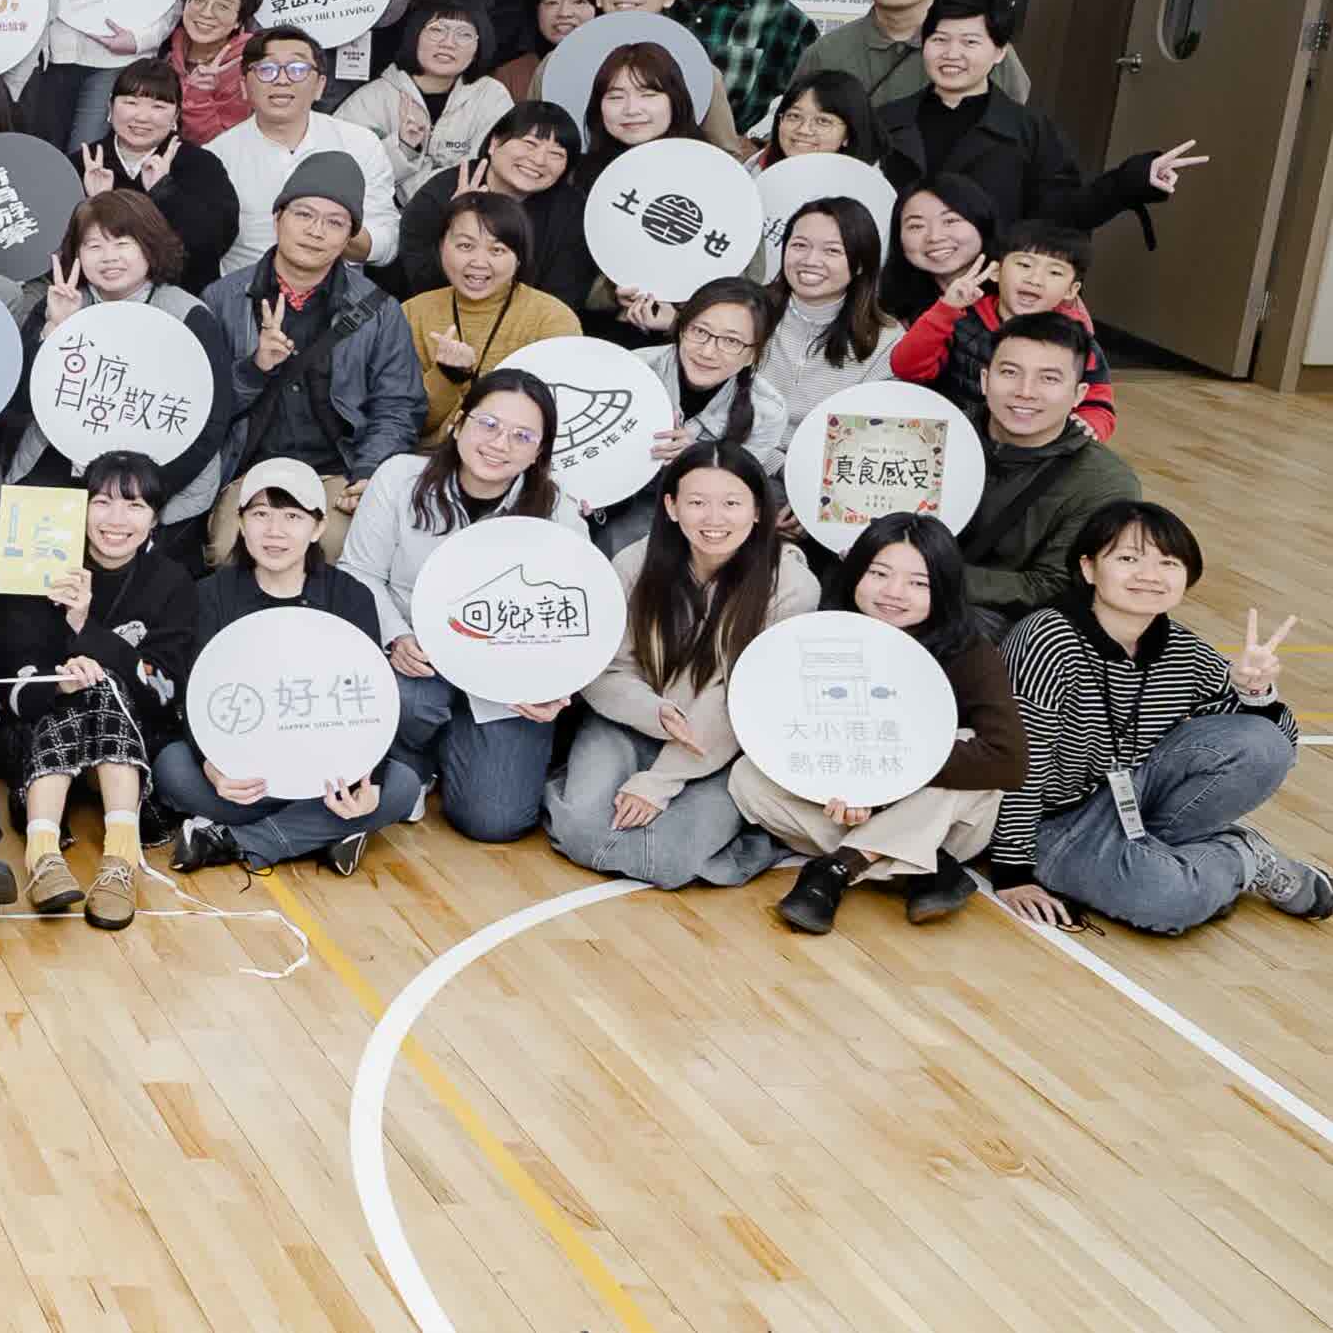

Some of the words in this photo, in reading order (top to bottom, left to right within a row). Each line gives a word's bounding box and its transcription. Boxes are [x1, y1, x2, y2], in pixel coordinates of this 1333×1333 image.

[338, 5, 375, 20] LIVING
[834, 454, 929, 490] 真食感受
[274, 667, 376, 718] 好伴
